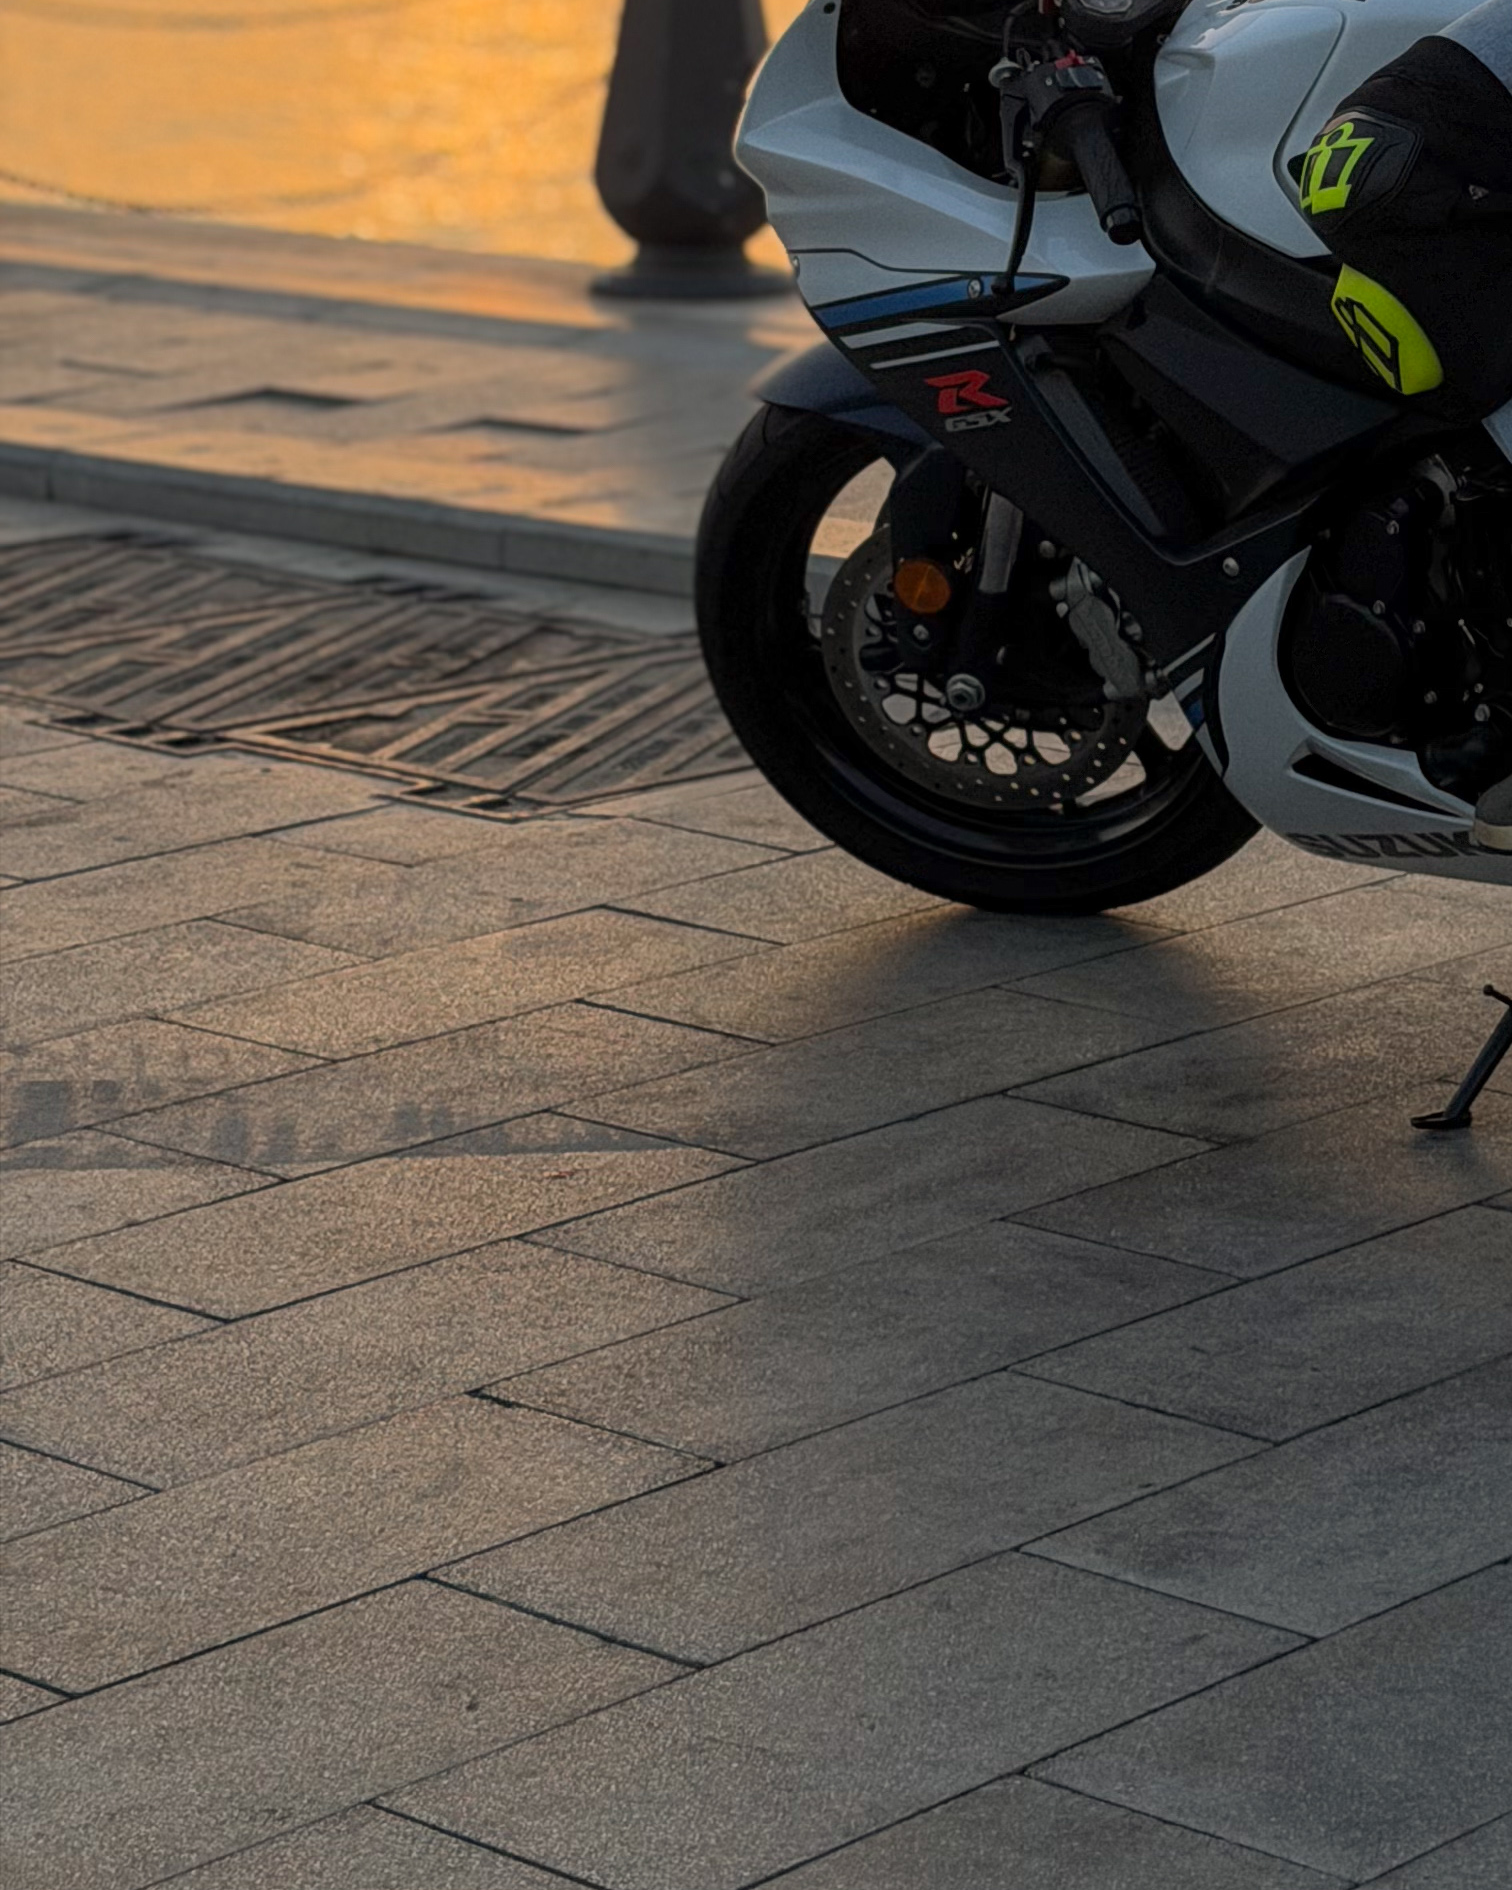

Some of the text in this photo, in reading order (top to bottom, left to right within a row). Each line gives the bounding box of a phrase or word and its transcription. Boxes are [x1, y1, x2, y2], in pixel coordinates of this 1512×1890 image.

[925, 370, 1010, 413] R
[945, 407, 1012, 432] GSX
[1286, 832, 1480, 858] SUZUK
